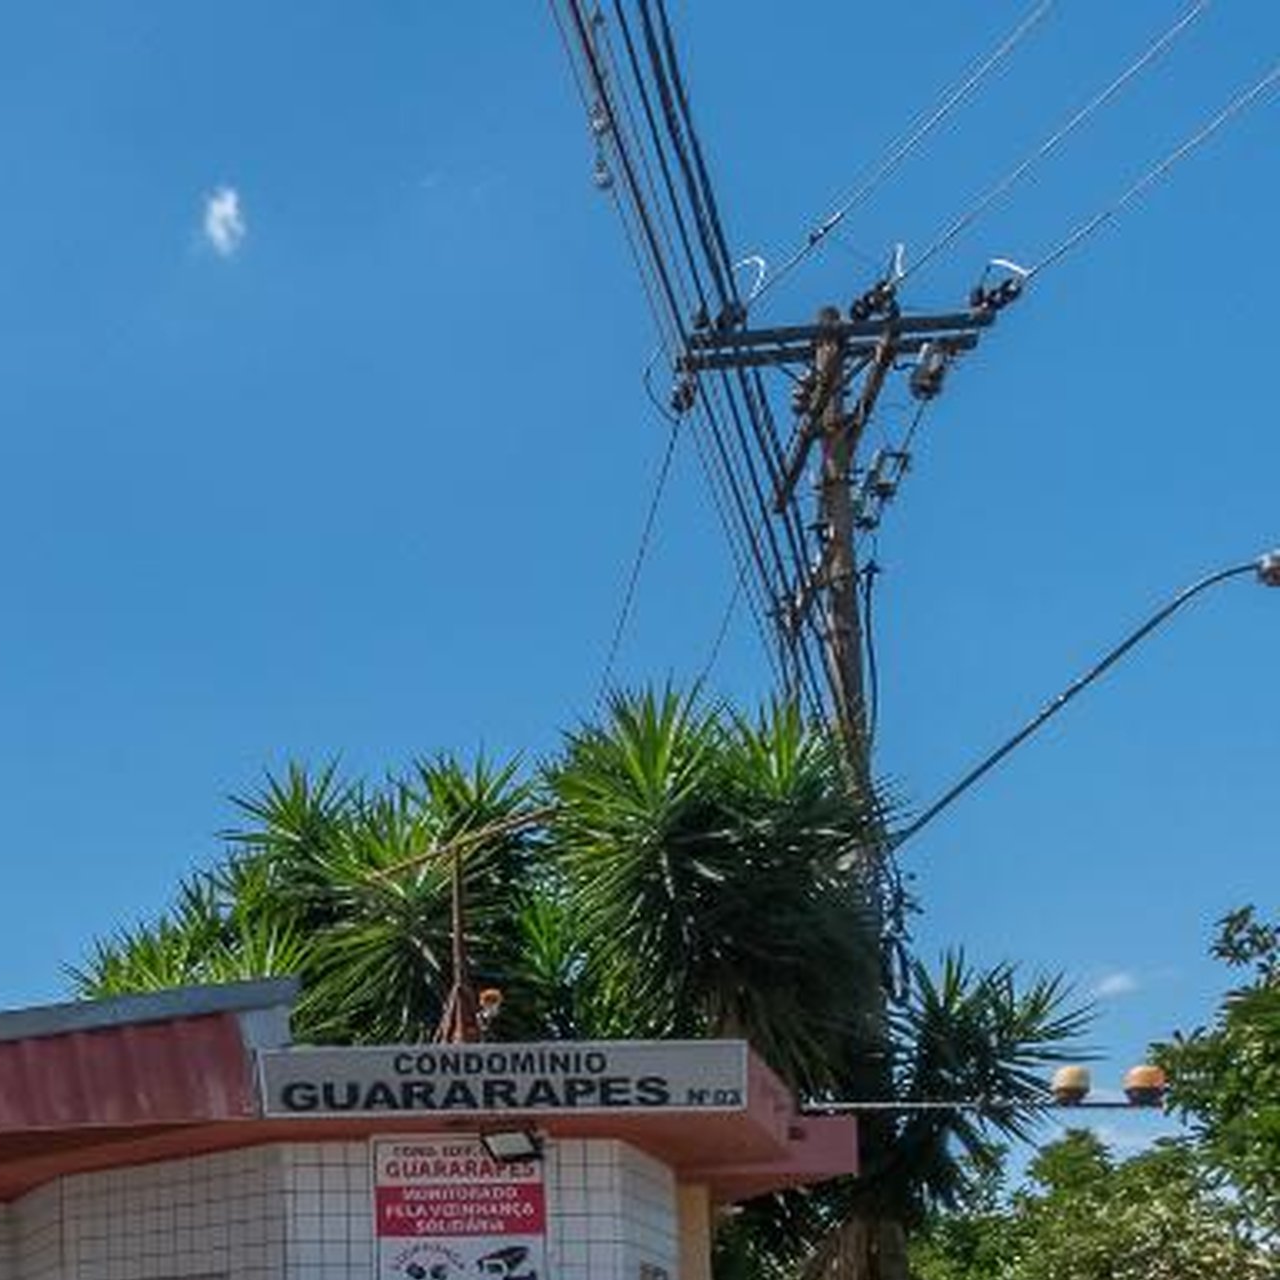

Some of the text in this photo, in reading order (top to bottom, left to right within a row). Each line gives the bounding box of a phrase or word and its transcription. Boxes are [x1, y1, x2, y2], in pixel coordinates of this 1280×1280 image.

[394, 1052, 607, 1075] CONDOMINIO
[281, 1076, 670, 1111] GUARARAPES
[385, 1159, 534, 1179] GUARARAPES
